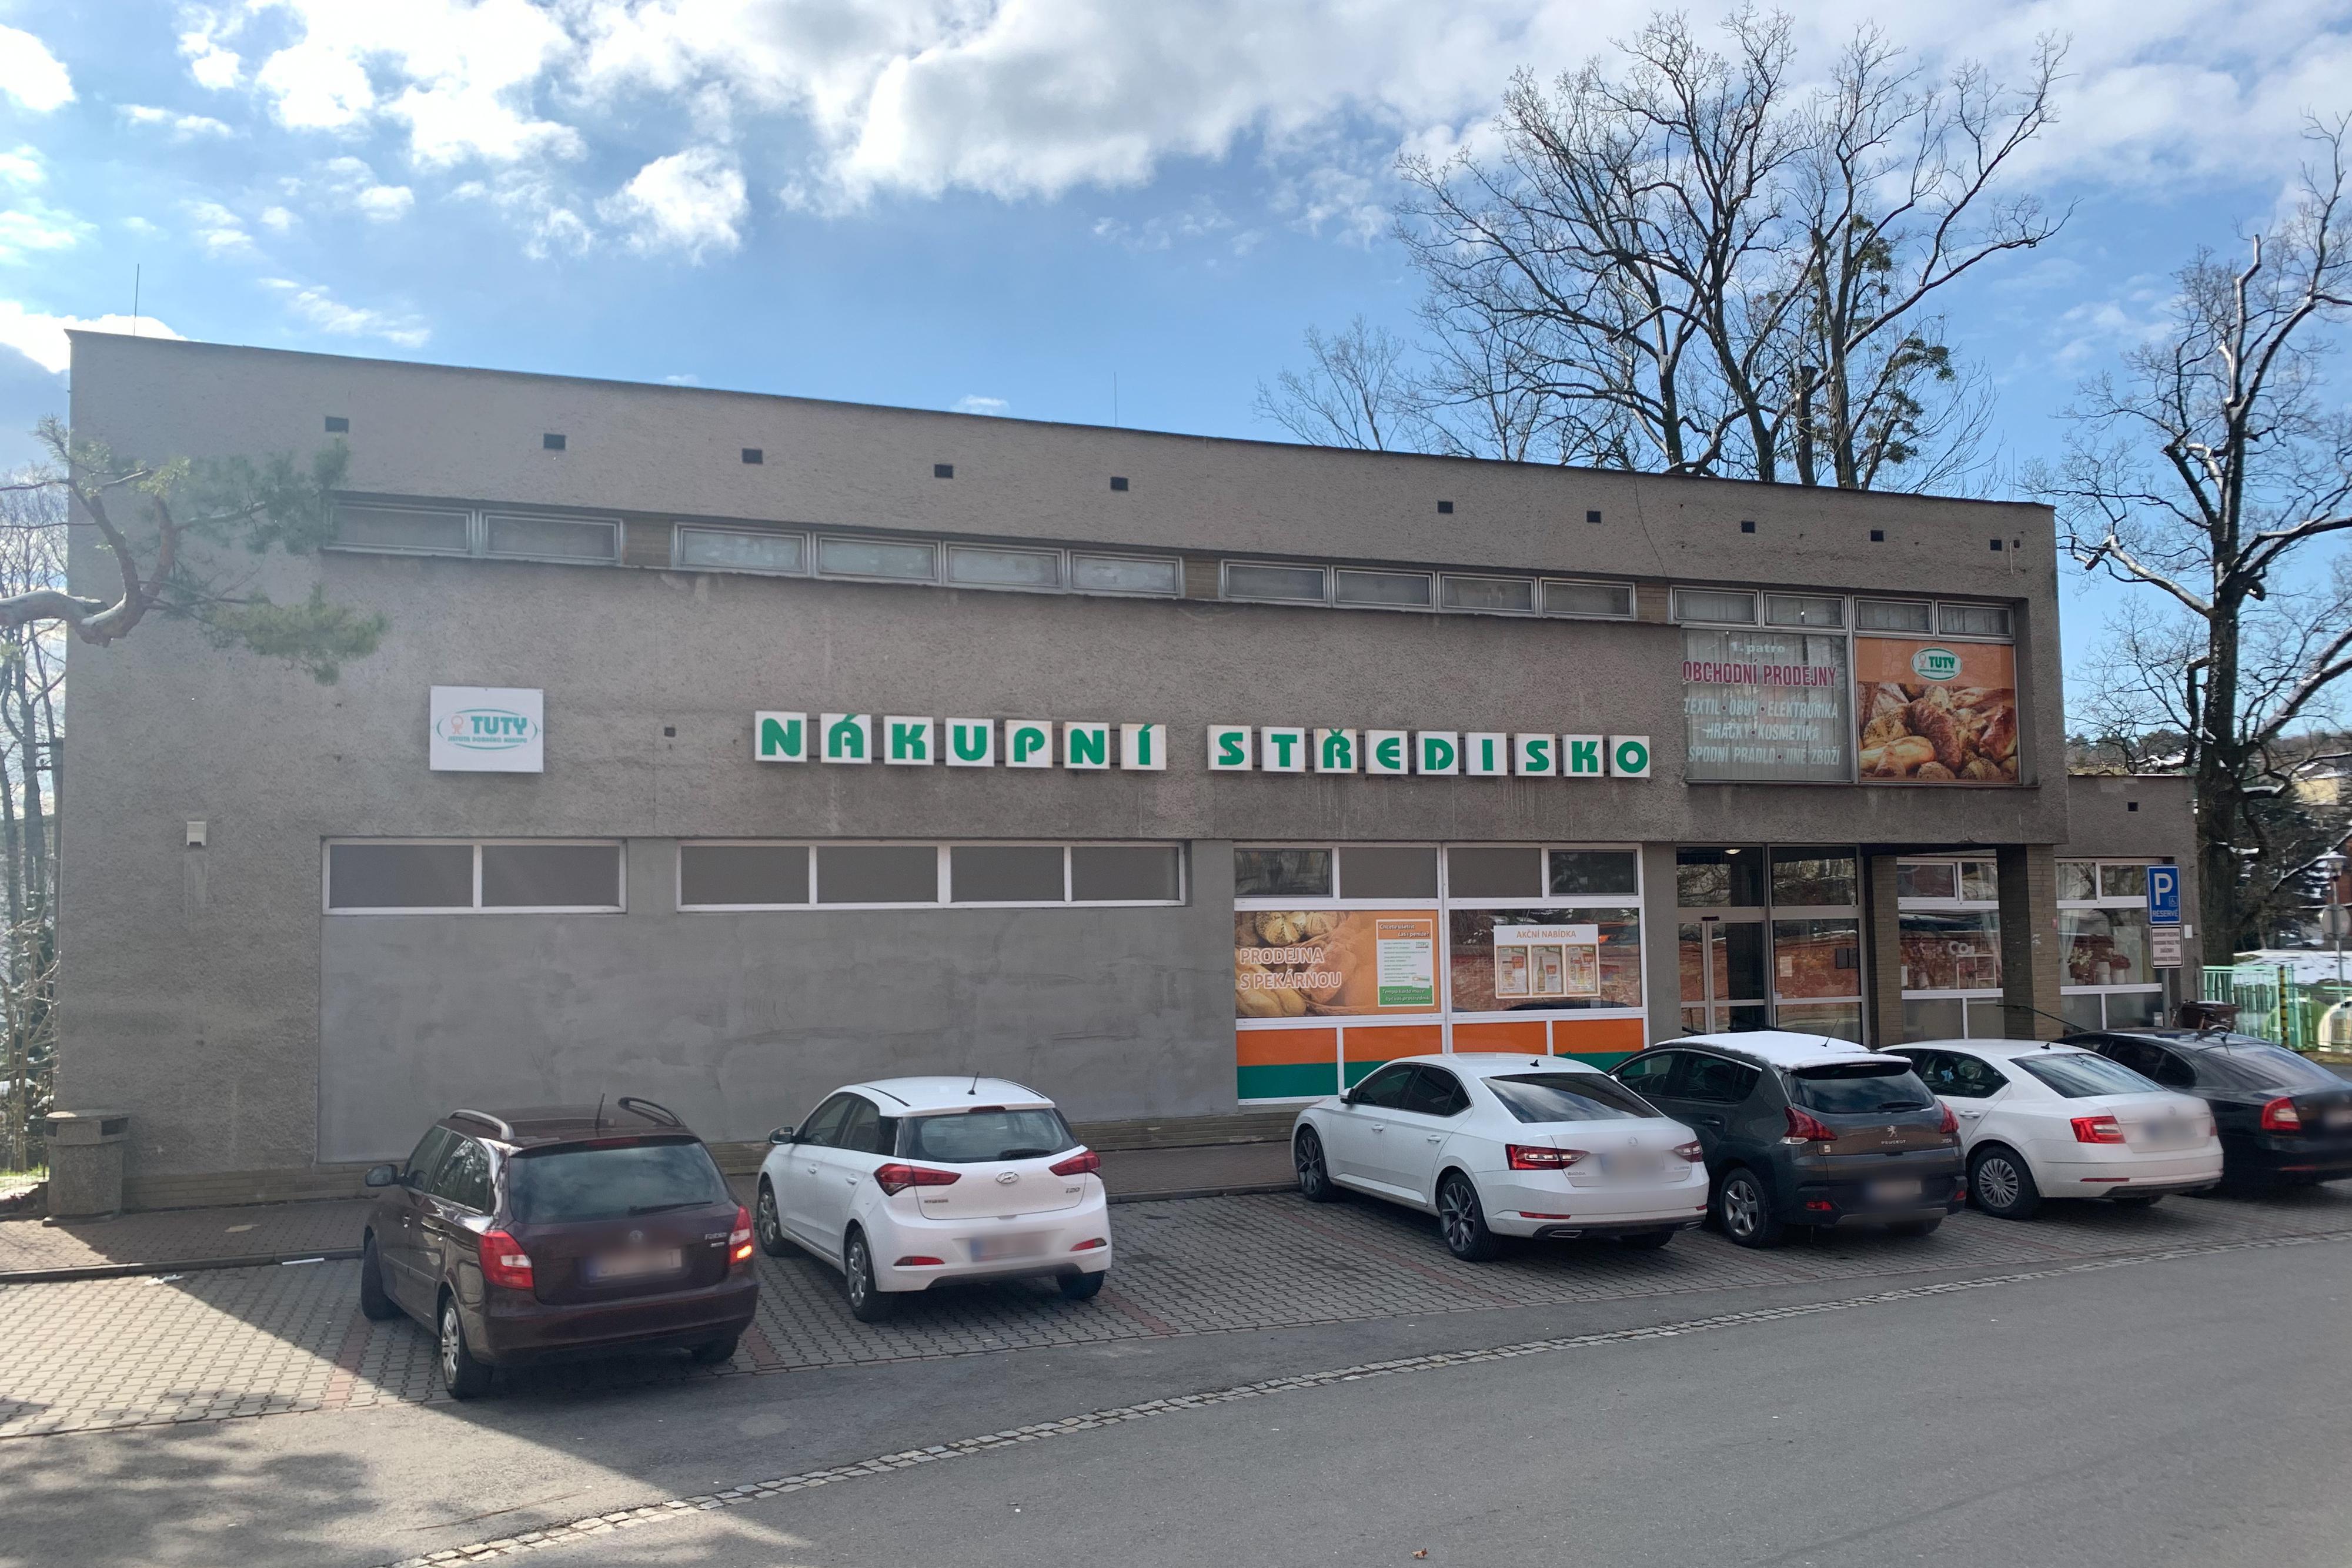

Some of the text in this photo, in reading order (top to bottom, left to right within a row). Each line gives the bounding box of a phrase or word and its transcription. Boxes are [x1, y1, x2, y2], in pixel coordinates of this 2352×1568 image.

[1746, 643, 1785, 654] patro
[1929, 656, 1955, 668] TUTY
[1682, 658, 1837, 687] OBCHODNÍ PRODEJNY
[1684, 698, 1720, 716] TEXTIL
[1767, 701, 1838, 718] ELEKTRONIKA
[471, 716, 527, 735] TUTY
[1758, 724, 1819, 741] KOSMETIKA
[761, 714, 1648, 774] NÁKUPNÍ STŘEDISKO
[1688, 743, 1841, 765] SPODNÍ PRÁDLO JINÉ ZBOŽÍ
[2154, 873, 2173, 905] P
[1516, 929, 1576, 938] AKČNÍ NABÍDKA
[1240, 947, 1324, 965] PRODEJNA
[1240, 969, 1342, 989] S PEKÁRNOU
